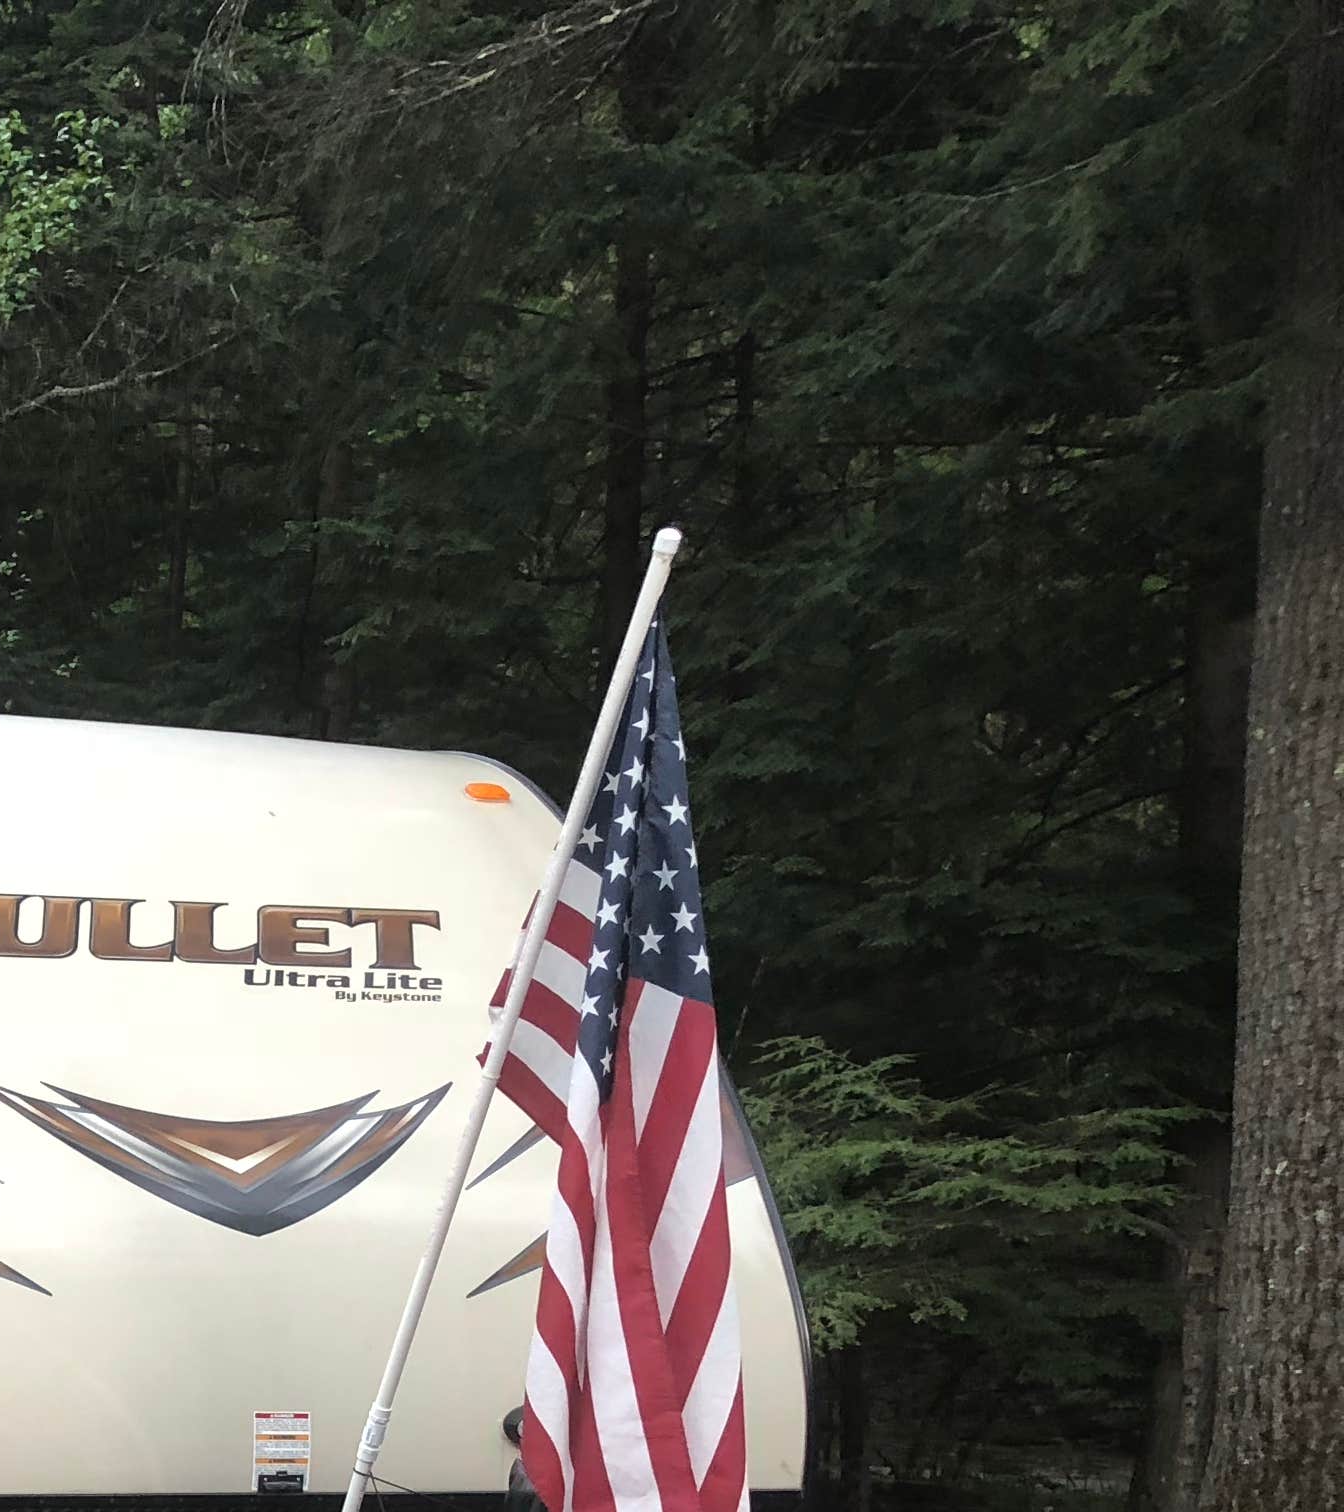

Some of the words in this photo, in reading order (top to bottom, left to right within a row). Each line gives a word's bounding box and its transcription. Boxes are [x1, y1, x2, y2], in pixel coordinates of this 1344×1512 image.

[244, 969, 351, 988] Ultra
[364, 972, 443, 990] Lite
[335, 991, 356, 1003] By
[362, 991, 442, 1003] Keystone
